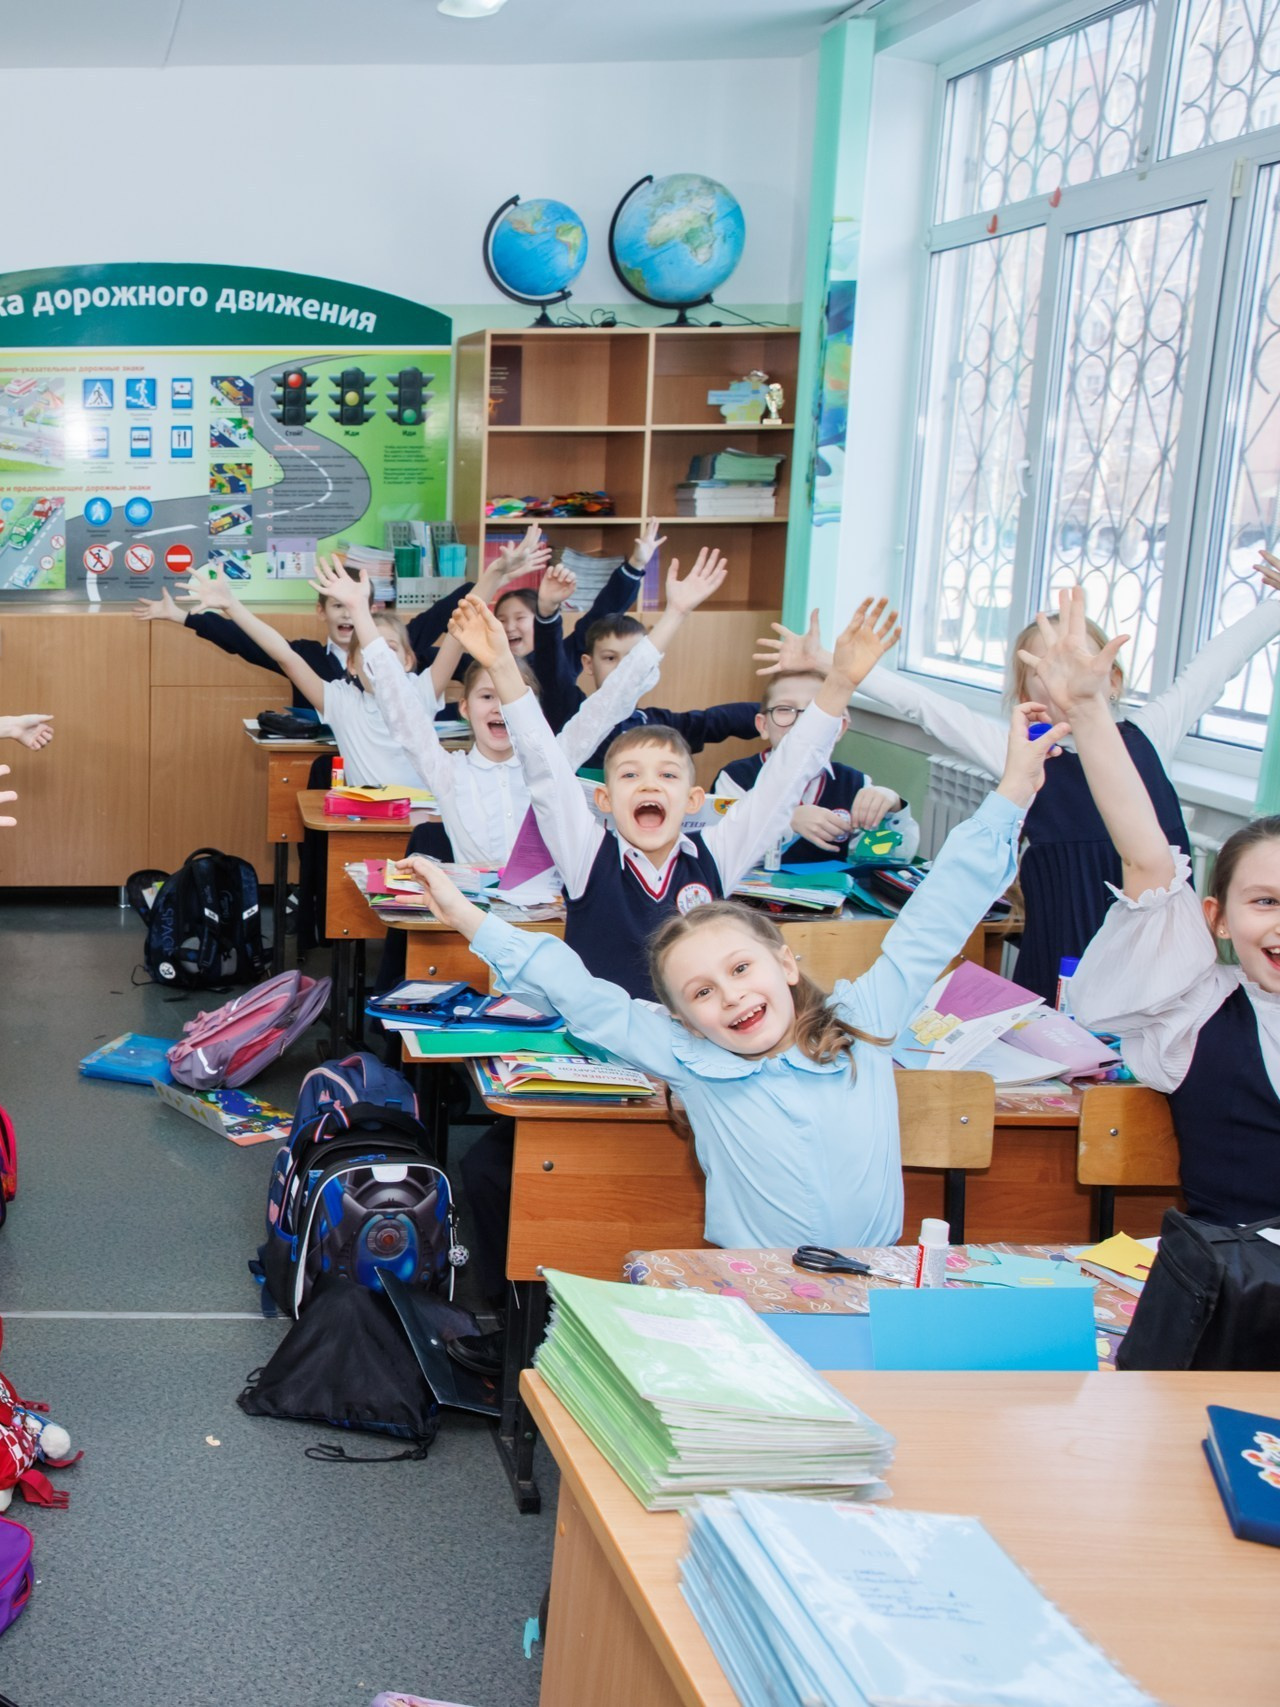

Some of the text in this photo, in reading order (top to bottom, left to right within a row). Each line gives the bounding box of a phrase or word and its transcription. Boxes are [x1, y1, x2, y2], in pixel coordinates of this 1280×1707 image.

[32, 285, 209, 317] дорожного
[215, 288, 378, 334] движения
[78, 365, 120, 373] дорожные
[285, 429, 303, 437] Стой!
[573, 1073, 632, 1081] BRAUBERG
